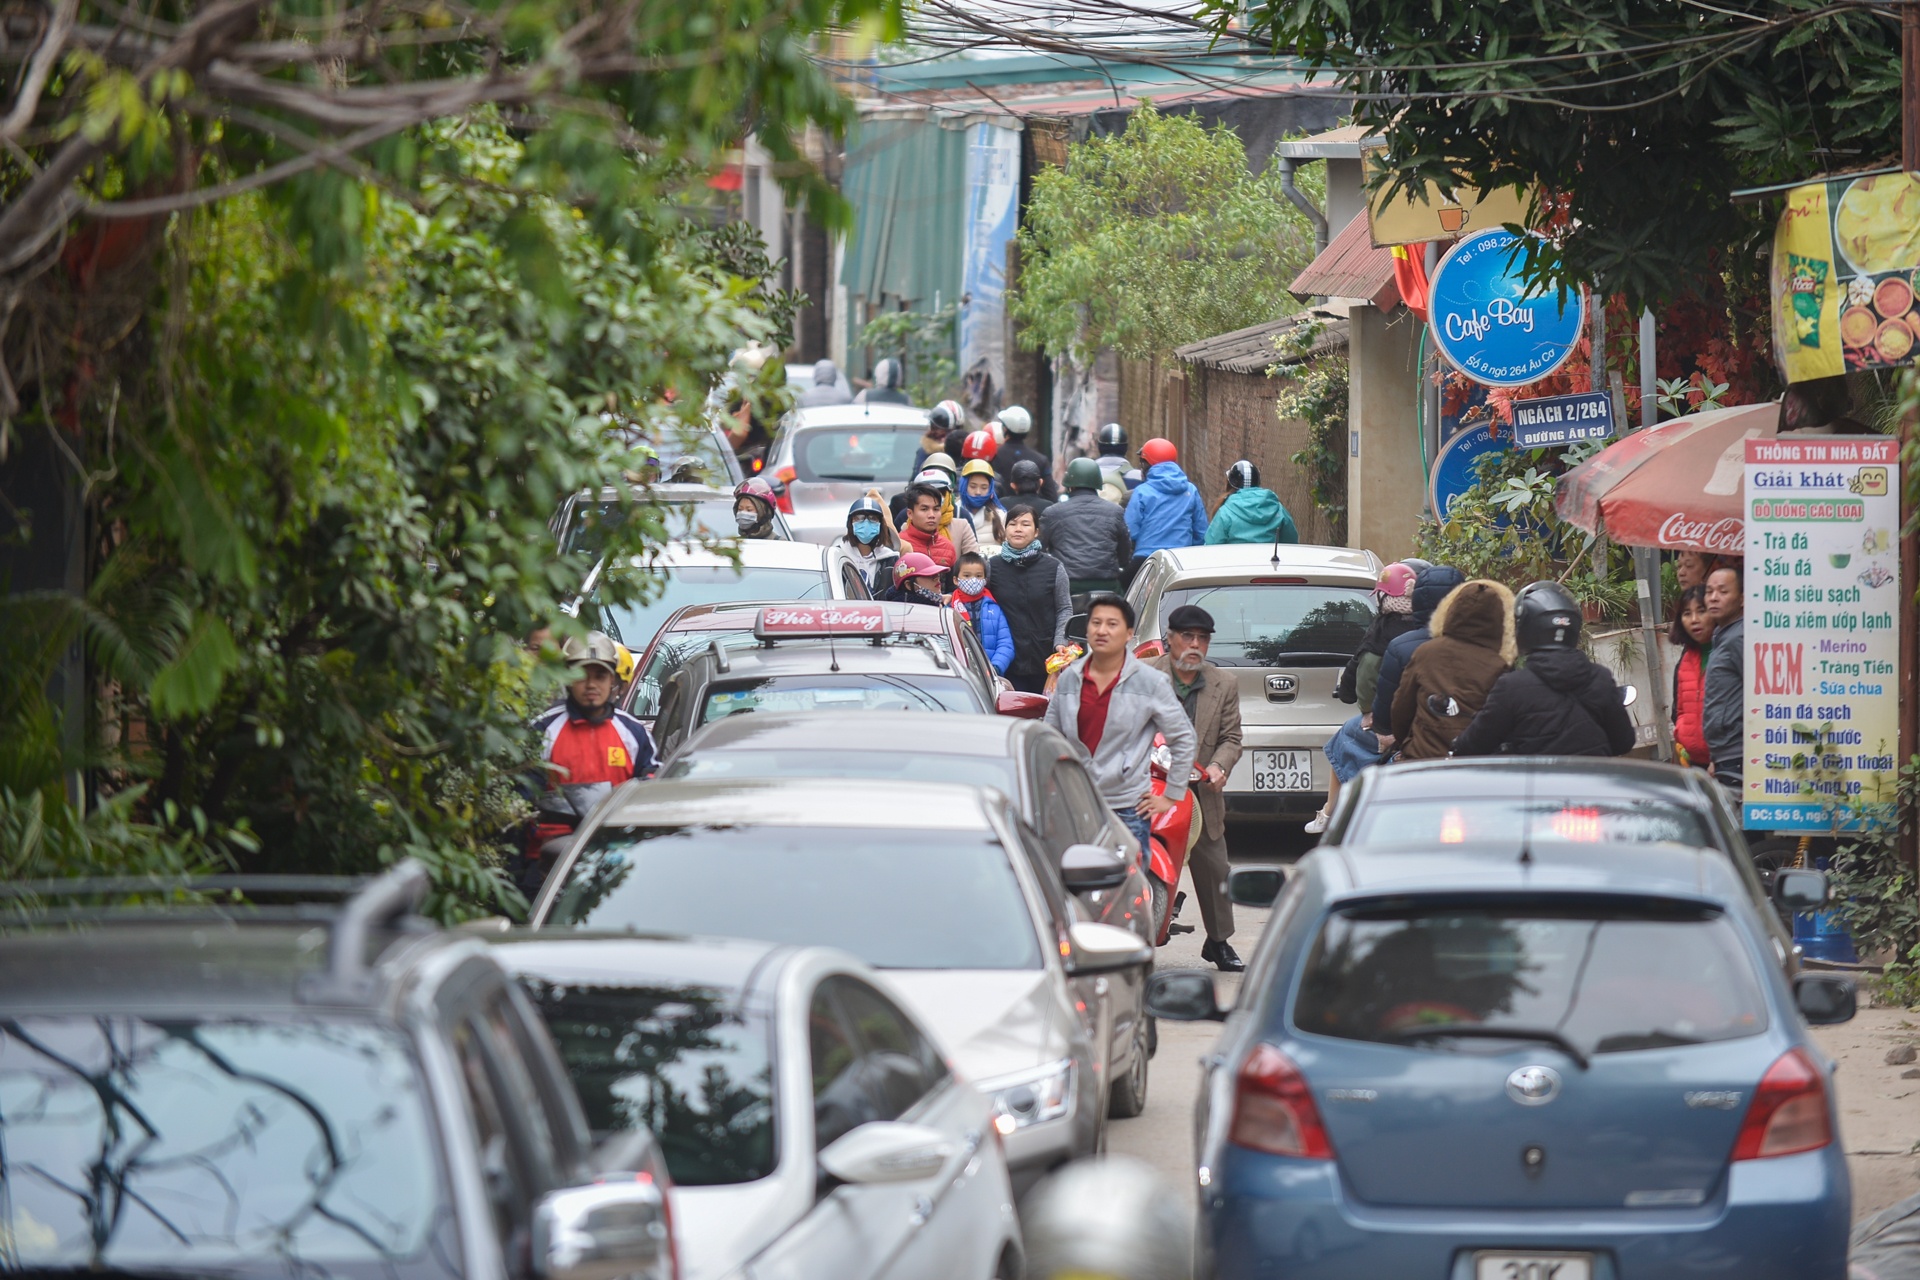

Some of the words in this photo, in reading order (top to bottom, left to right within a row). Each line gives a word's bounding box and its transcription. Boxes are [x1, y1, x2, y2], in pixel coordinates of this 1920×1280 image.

[1456, 251, 1472, 266] Tel
[1445, 308, 1491, 341] Cafe
[1487, 298, 1534, 333] Bay
[1466, 356, 1482, 369] Số
[1481, 363, 1489, 372] 8
[1488, 367, 1508, 378] ngõ
[1510, 365, 1527, 376] 264
[1529, 358, 1542, 371] Âu
[1541, 348, 1556, 362] Cơ
[1518, 405, 1563, 426] NGÁCH
[1566, 401, 1607, 422] 2/264
[1524, 429, 1565, 444] ĐƯỜNG
[1569, 425, 1586, 440] ÂU
[1589, 425, 1606, 438] CƠ
[1458, 441, 1472, 453] Tel
[1755, 443, 1800, 460] THÔNG
[1804, 446, 1827, 460] TIN
[1830, 444, 1858, 460] NHÀ
[1862, 440, 1889, 460] ĐẤT
[1754, 470, 1793, 488] Giải
[1800, 471, 1844, 488] khát
[1755, 500, 1771, 517] ĐỒ
[1774, 500, 1807, 518] UỐNG
[1810, 501, 1833, 518] CÁC
[1837, 503, 1862, 521] LOẠI
[1764, 531, 1786, 550] Trà
[1791, 531, 1808, 550] đá
[1764, 556, 1789, 576] Sấu
[1795, 558, 1812, 576] đá
[1764, 585, 1790, 603] Mía
[1794, 584, 1823, 603] siêu
[1827, 585, 1861, 607] sạch
[765, 611, 814, 625] Phù
[1764, 610, 1790, 628] Dừa
[1795, 610, 1827, 628] xiêm
[1832, 612, 1857, 633] ướp
[1862, 611, 1892, 633] lạnh
[1820, 639, 1867, 653] Merino
[1754, 642, 1803, 695] KEM
[1820, 660, 1860, 677] Tràng
[1272, 680, 1291, 689] KIA
[1850, 681, 1883, 695] chua
[1765, 704, 1791, 719] Bán
[1796, 704, 1813, 719] đá
[1817, 704, 1851, 722] sạch
[1267, 752, 1298, 770] 30A
[1255, 771, 1310, 789] 833.26
[1845, 781, 1861, 794] xe
[1750, 809, 1772, 820] ĐC:
